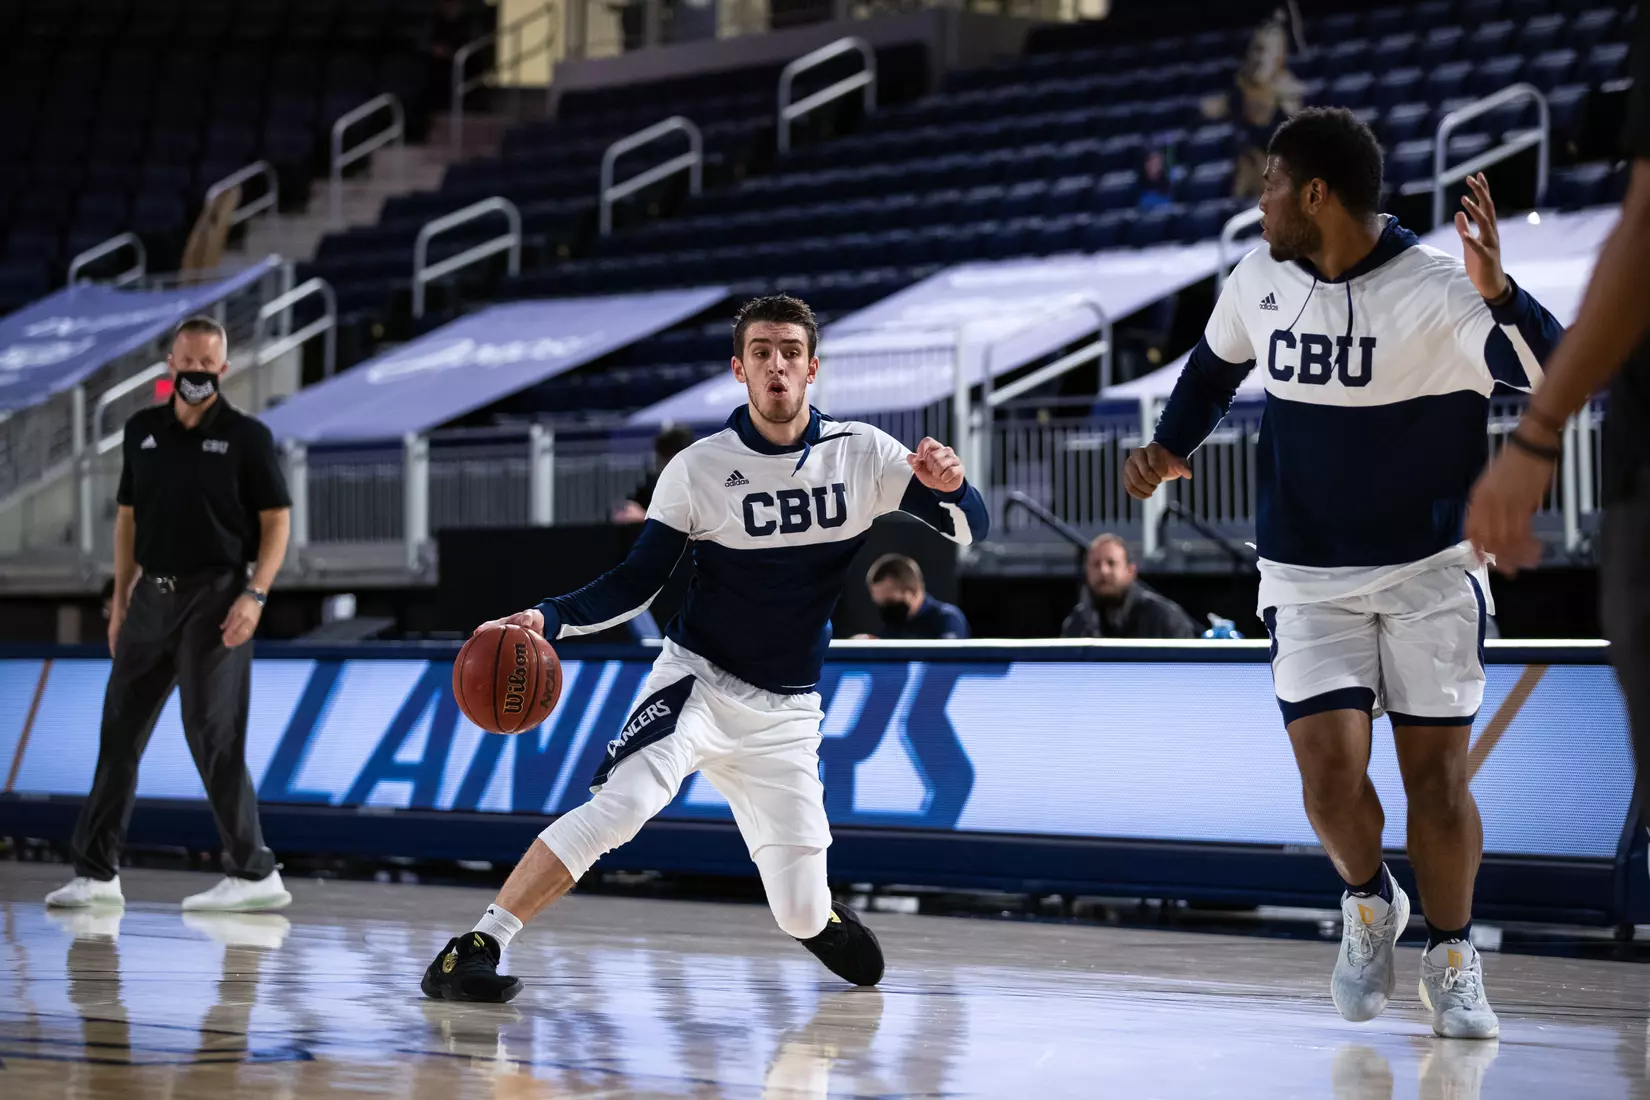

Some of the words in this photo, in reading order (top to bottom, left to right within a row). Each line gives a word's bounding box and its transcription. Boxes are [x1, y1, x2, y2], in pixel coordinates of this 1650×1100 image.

[1268, 329, 1377, 387] CBU
[202, 438, 229, 455] CBU
[725, 478, 750, 488] adidas
[742, 482, 847, 537] CBU
[503, 642, 528, 714] Wilson
[256, 660, 1012, 829] LANRS
